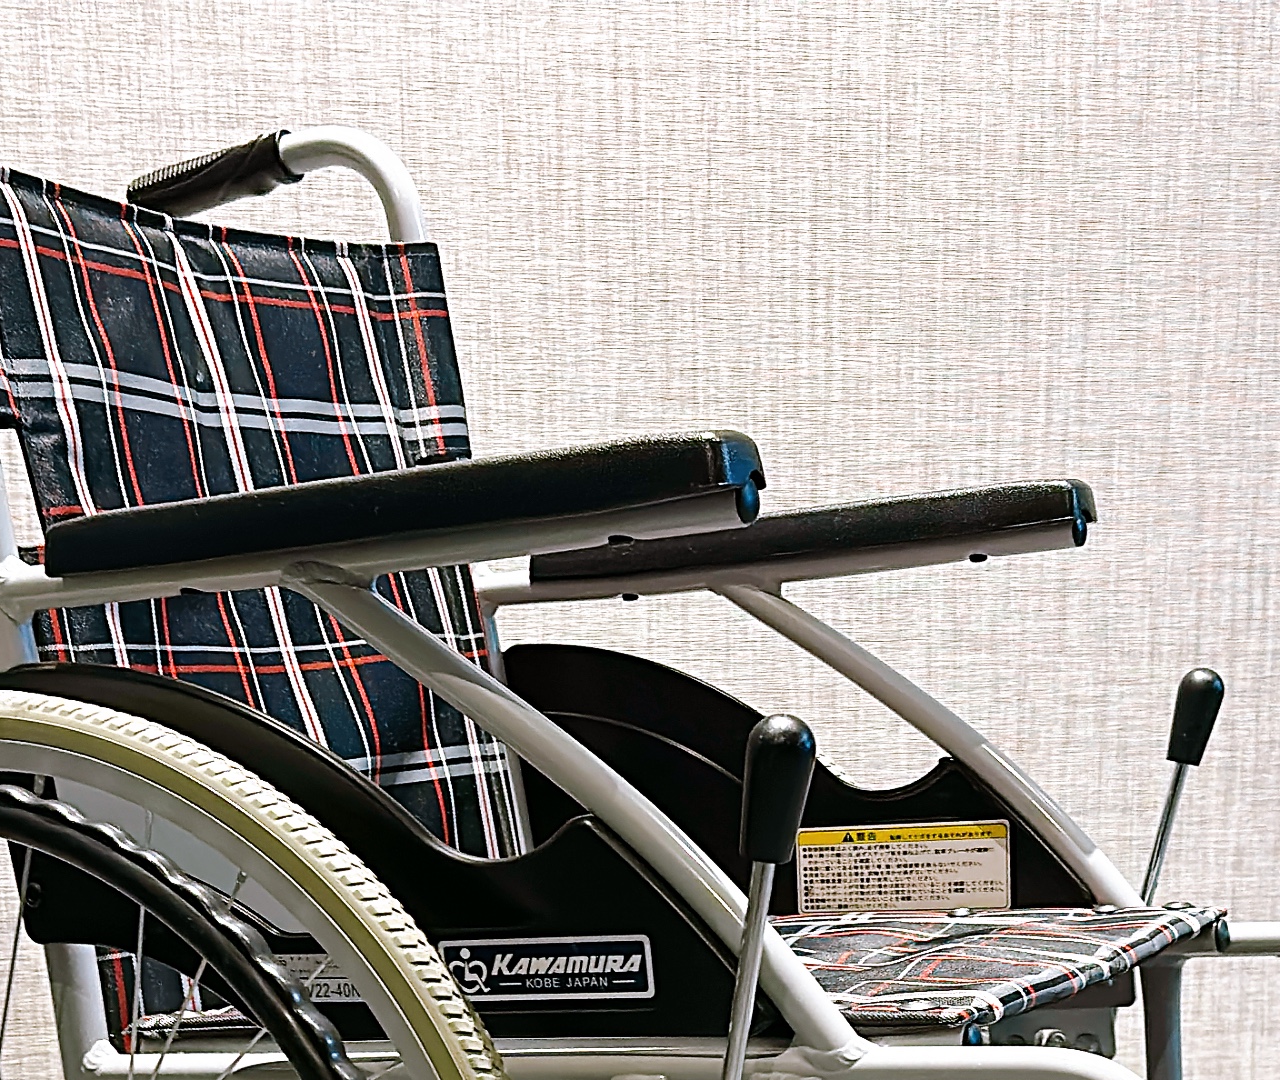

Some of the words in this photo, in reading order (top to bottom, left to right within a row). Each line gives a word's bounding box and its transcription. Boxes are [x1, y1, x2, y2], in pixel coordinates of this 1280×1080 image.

[491, 953, 642, 976] KAWAMURA
[525, 977, 560, 988] KOBE
[565, 976, 608, 988] JAPAN
